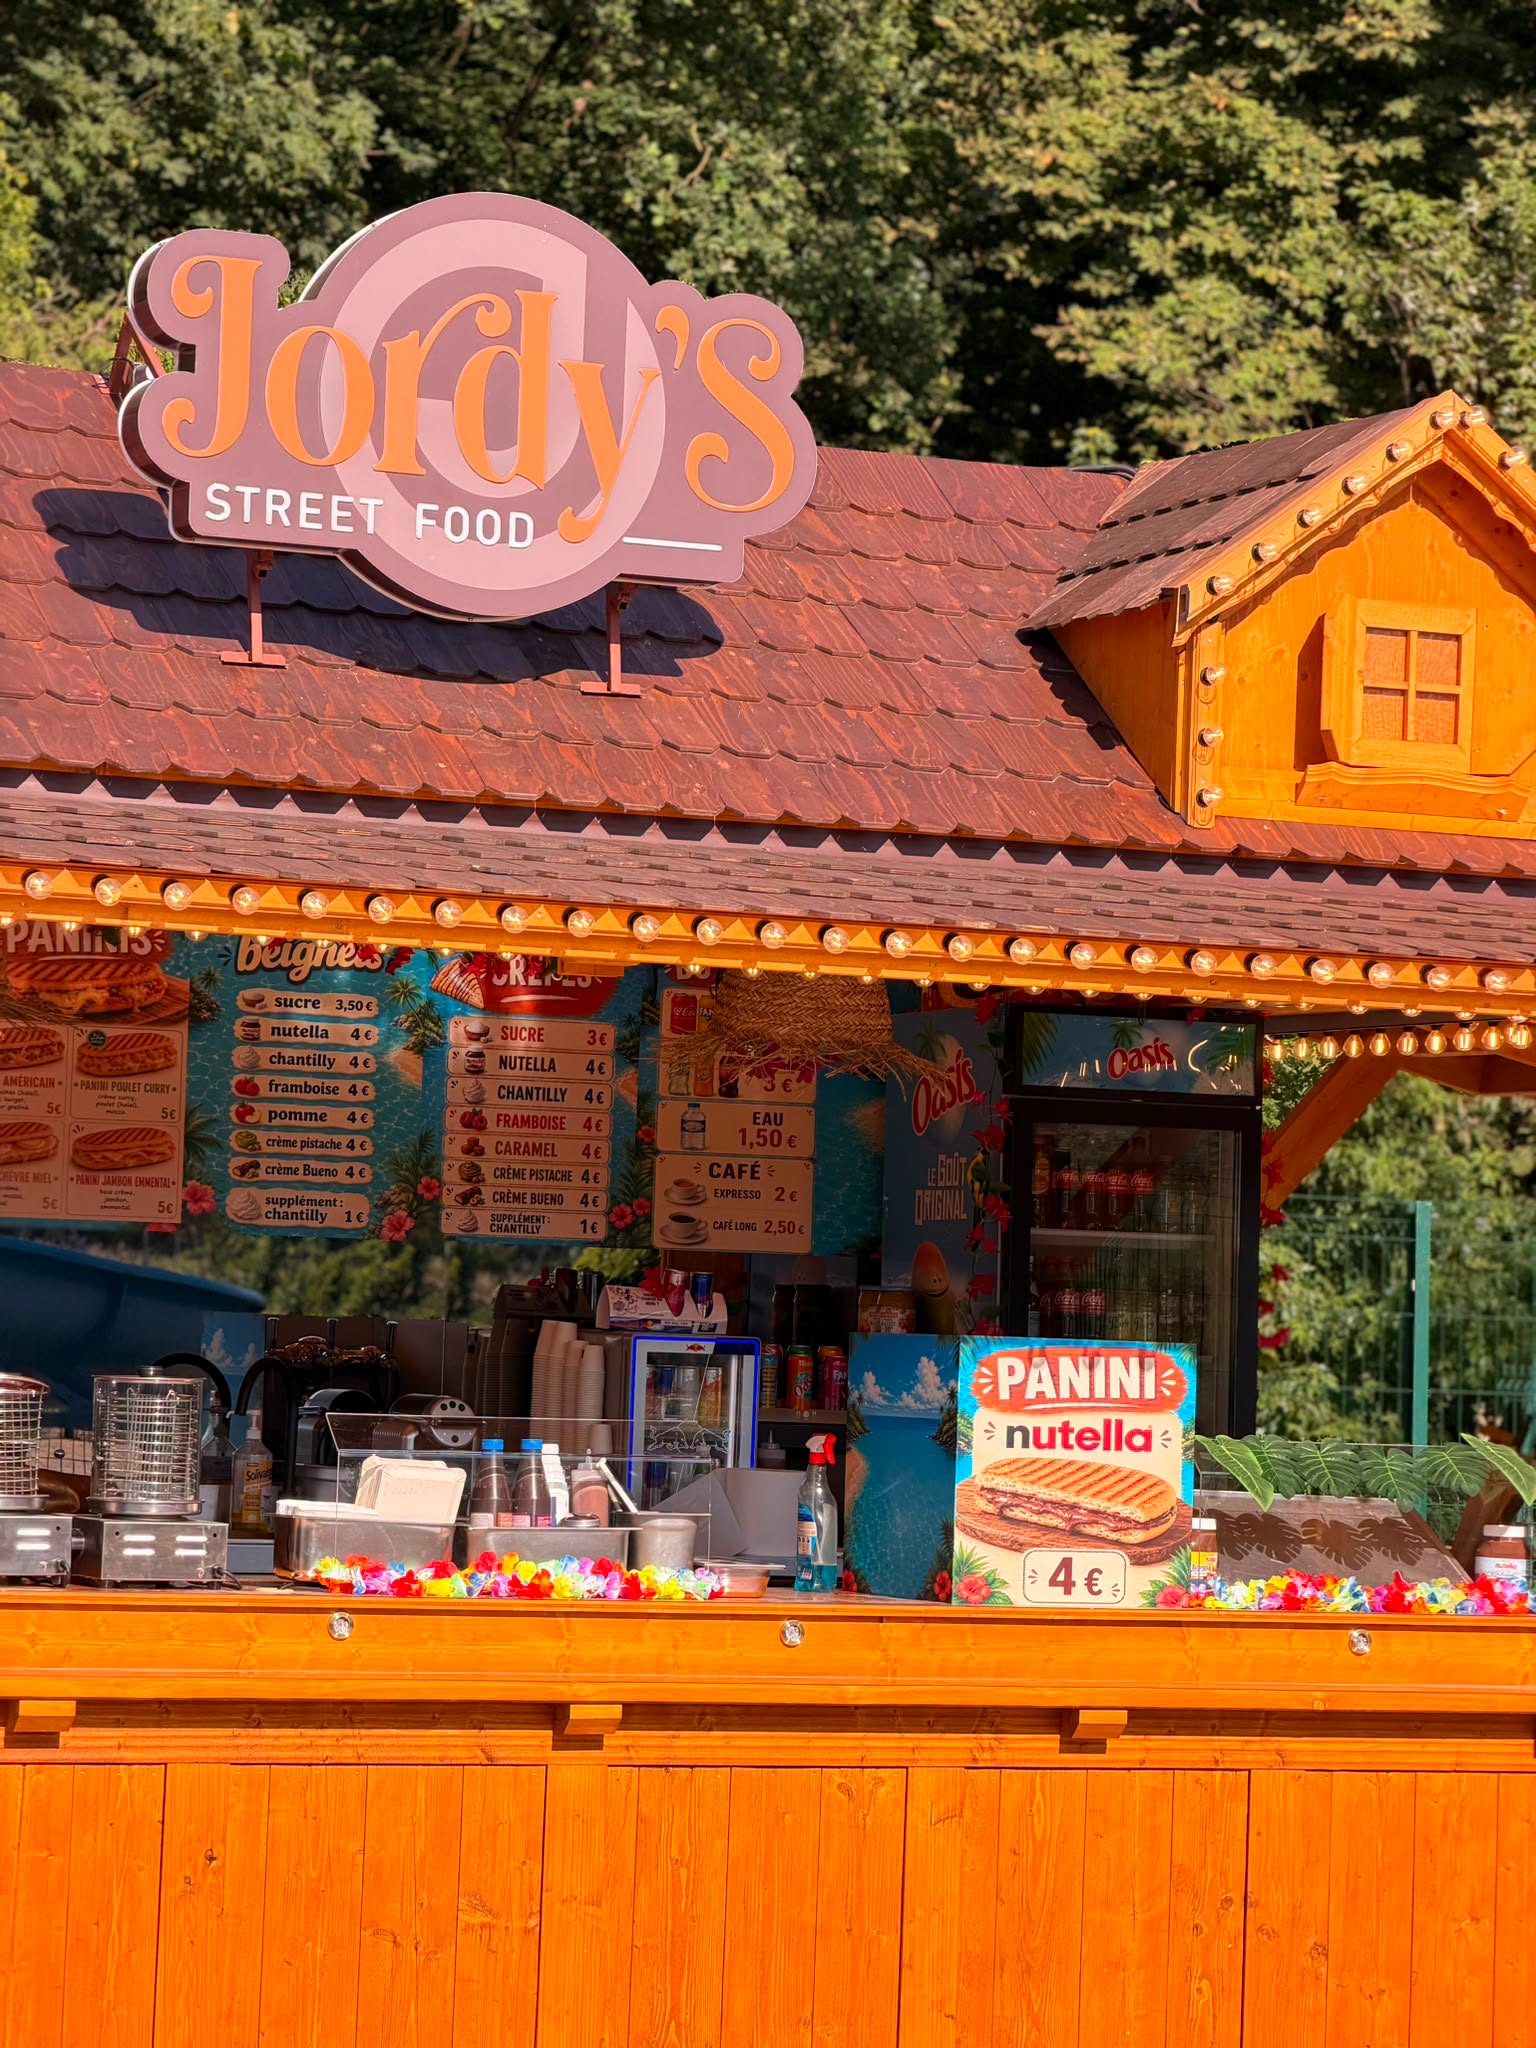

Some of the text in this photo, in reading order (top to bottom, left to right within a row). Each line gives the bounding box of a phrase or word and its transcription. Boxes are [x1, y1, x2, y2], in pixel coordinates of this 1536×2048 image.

[205, 483, 536, 549] STREET FOOD
[274, 996, 373, 1012] sucre 3,50 €
[270, 1025, 372, 1040] nutella 4 €
[500, 1025, 607, 1046] SUCRE 3 €
[269, 1052, 371, 1070] chantilly 4 €
[498, 1055, 556, 1073] NUTELLA
[585, 1059, 595, 1075] 4
[598, 1062, 606, 1075] €
[1108, 1037, 1175, 1079] Oasis
[80, 1081, 171, 1095] PANINI POULET CURRY
[268, 1079, 370, 1096] framboise 4 €
[782, 1078, 792, 1093] €
[497, 1085, 604, 1104] CHANTILLY 4 €
[47, 1102, 62, 1115] 5€
[161, 1107, 176, 1120] 5€
[268, 1109, 368, 1123] pomme 4 €
[496, 1113, 603, 1132] FRAMBOISE 4 €
[752, 1112, 784, 1126] EAU
[266, 1136, 367, 1151] crème pistache 4 €
[738, 1128, 797, 1149] 1,50 €
[495, 1140, 602, 1159] CARAMEL 4 €
[265, 1163, 366, 1178] crème Bueno 4 €
[493, 1165, 600, 1184] CRÈME PISTACHE 4 €
[708, 1161, 761, 1180] CAFÉ
[927, 1168, 937, 1186] LE
[75, 1174, 171, 1189] PANINI JAMBON EMMENTAL
[492, 1189, 599, 1207] CRÈME BUENO 4 €
[713, 1186, 798, 1202] EXPRESSO 2 €
[42, 1197, 58, 1210] 5€
[158, 1201, 173, 1213] 5€
[915, 1189, 968, 1225] ORIGINAL
[264, 1208, 364, 1223] chantilly 1 €
[489, 1224, 542, 1234] CHANTILLY
[580, 1219, 598, 1233] 1 €
[713, 1220, 733, 1230] CAFÉ
[735, 1222, 757, 1231] LONG
[764, 1219, 795, 1235] 2,50
[997, 1356, 1156, 1401] PANINI
[1006, 1418, 1153, 1453] nutella
[1048, 1557, 1103, 1596] 4 €
